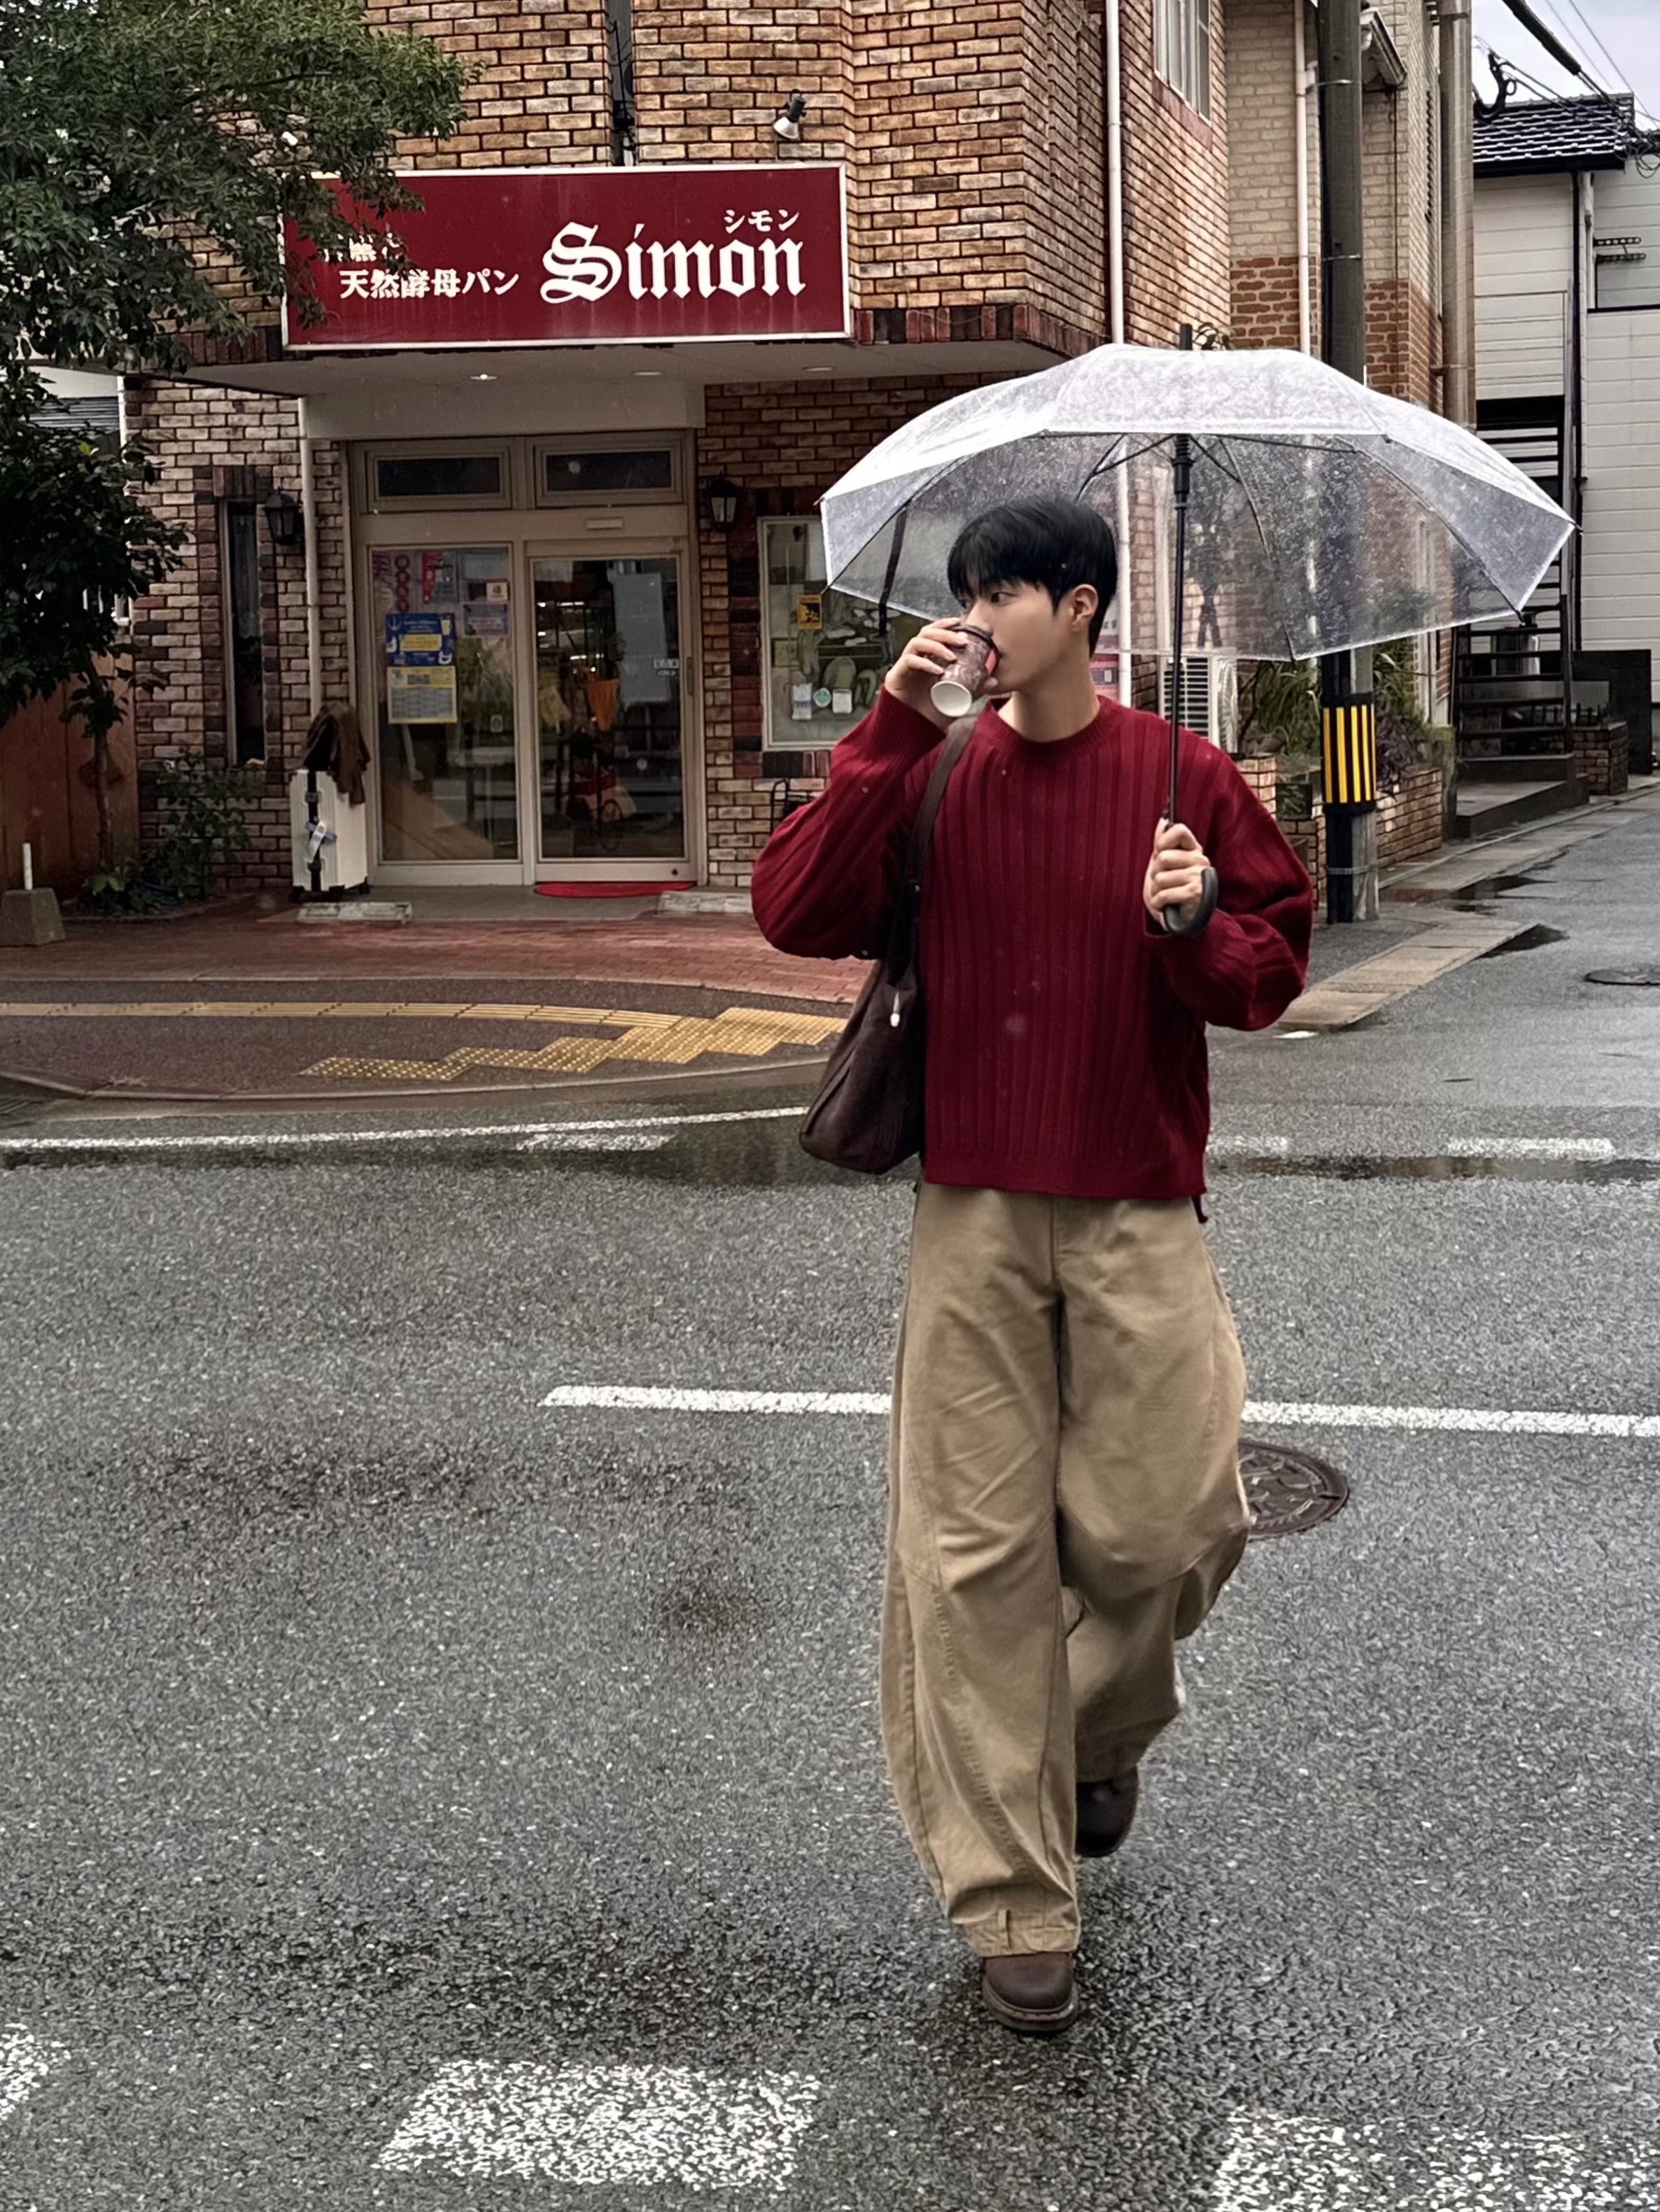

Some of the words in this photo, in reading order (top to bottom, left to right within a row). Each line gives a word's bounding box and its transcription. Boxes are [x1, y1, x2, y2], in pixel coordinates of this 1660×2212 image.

[724, 209, 799, 234] シモン
[540, 221, 806, 304] Simon
[339, 268, 519, 299] 天然酵母パン
